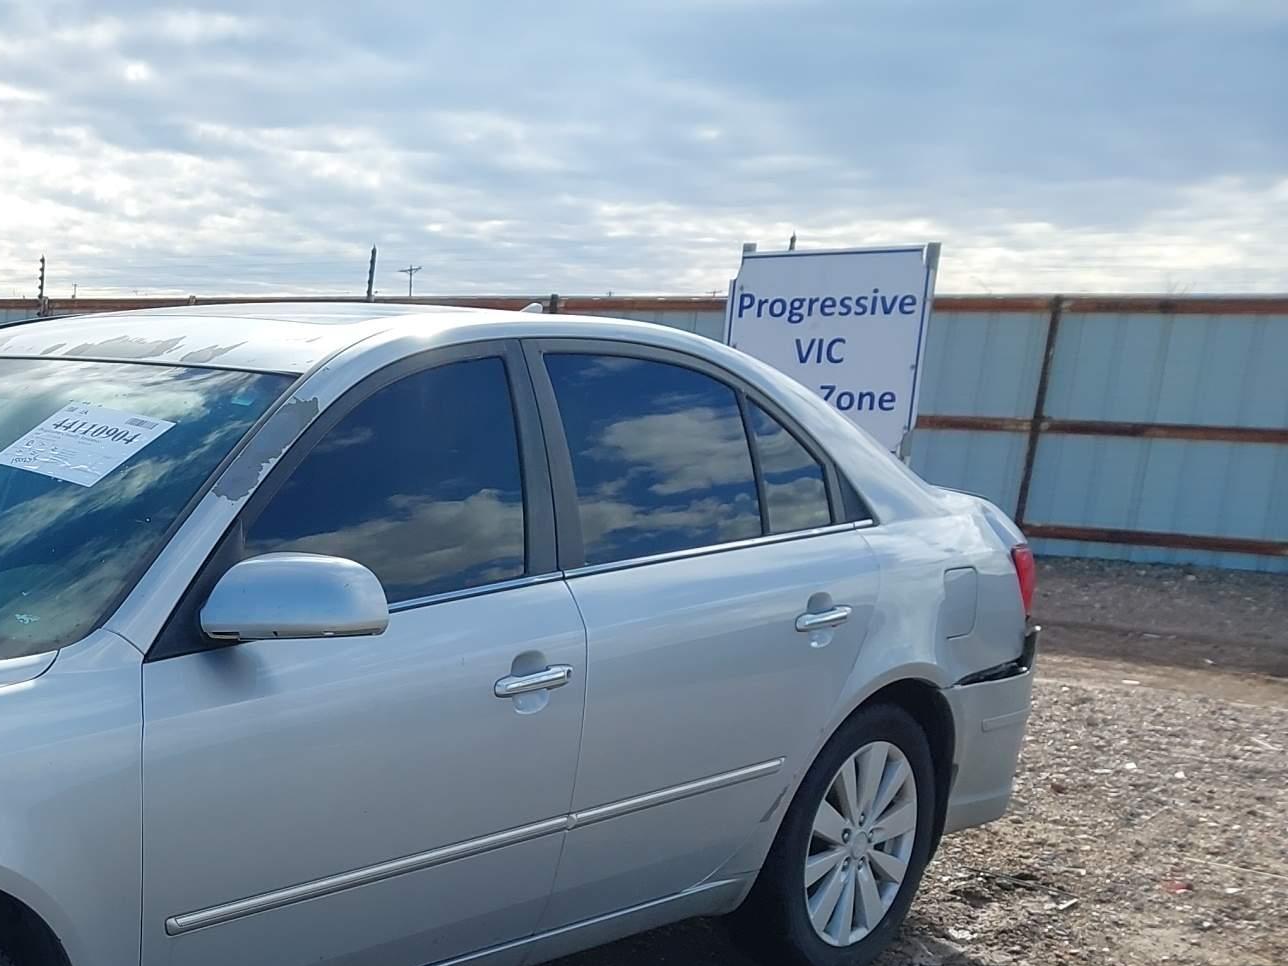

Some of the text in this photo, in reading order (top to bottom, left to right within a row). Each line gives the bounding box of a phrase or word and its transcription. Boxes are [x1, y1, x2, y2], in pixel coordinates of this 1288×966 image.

[737, 288, 918, 324] Progressive
[795, 336, 847, 365] VIC
[52, 417, 142, 445] 44110904
